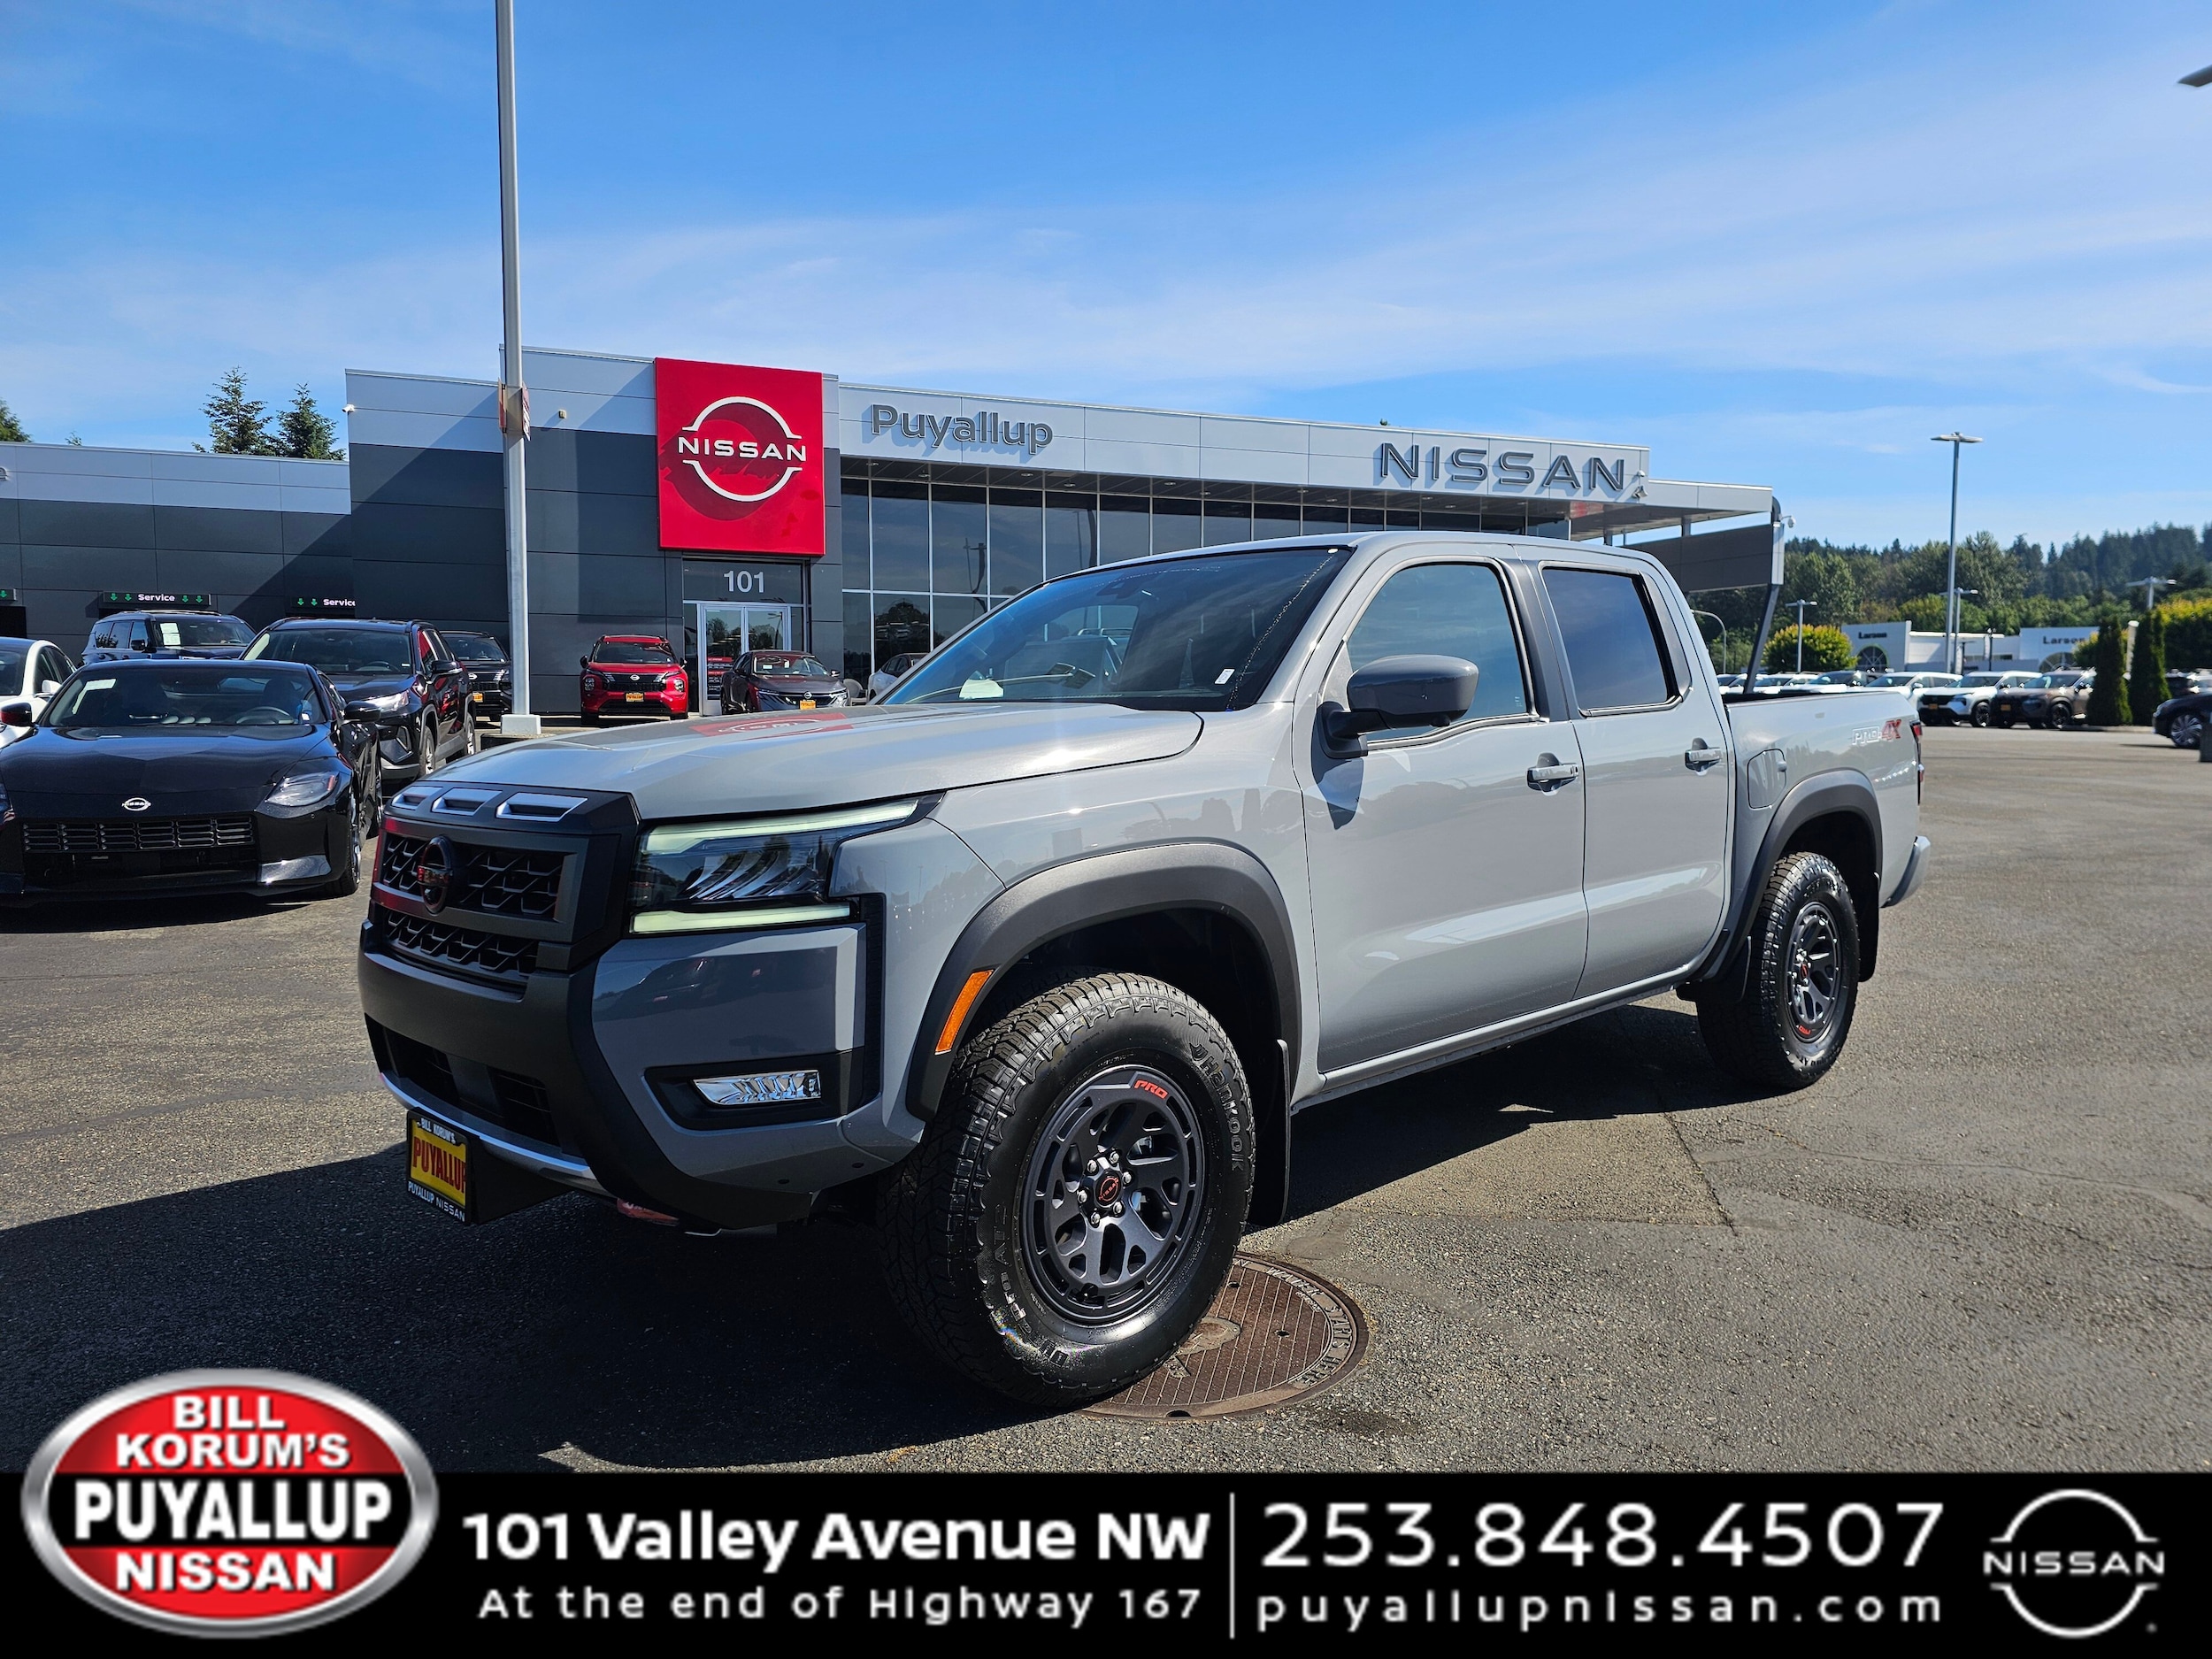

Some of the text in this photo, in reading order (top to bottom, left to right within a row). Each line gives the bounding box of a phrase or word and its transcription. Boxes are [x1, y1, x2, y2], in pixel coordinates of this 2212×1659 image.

[872, 404, 1053, 456] Puyallup
[678, 436, 807, 462] NISSAN
[1381, 442, 1624, 491] NISSAN
[723, 571, 765, 593] 101
[1133, 1079, 1170, 1100] PRO
[420, 1118, 432, 1133] BILL
[408, 1180, 465, 1222] PUYALLUP NISSAN
[1098, 1177, 1119, 1201] NISSAN
